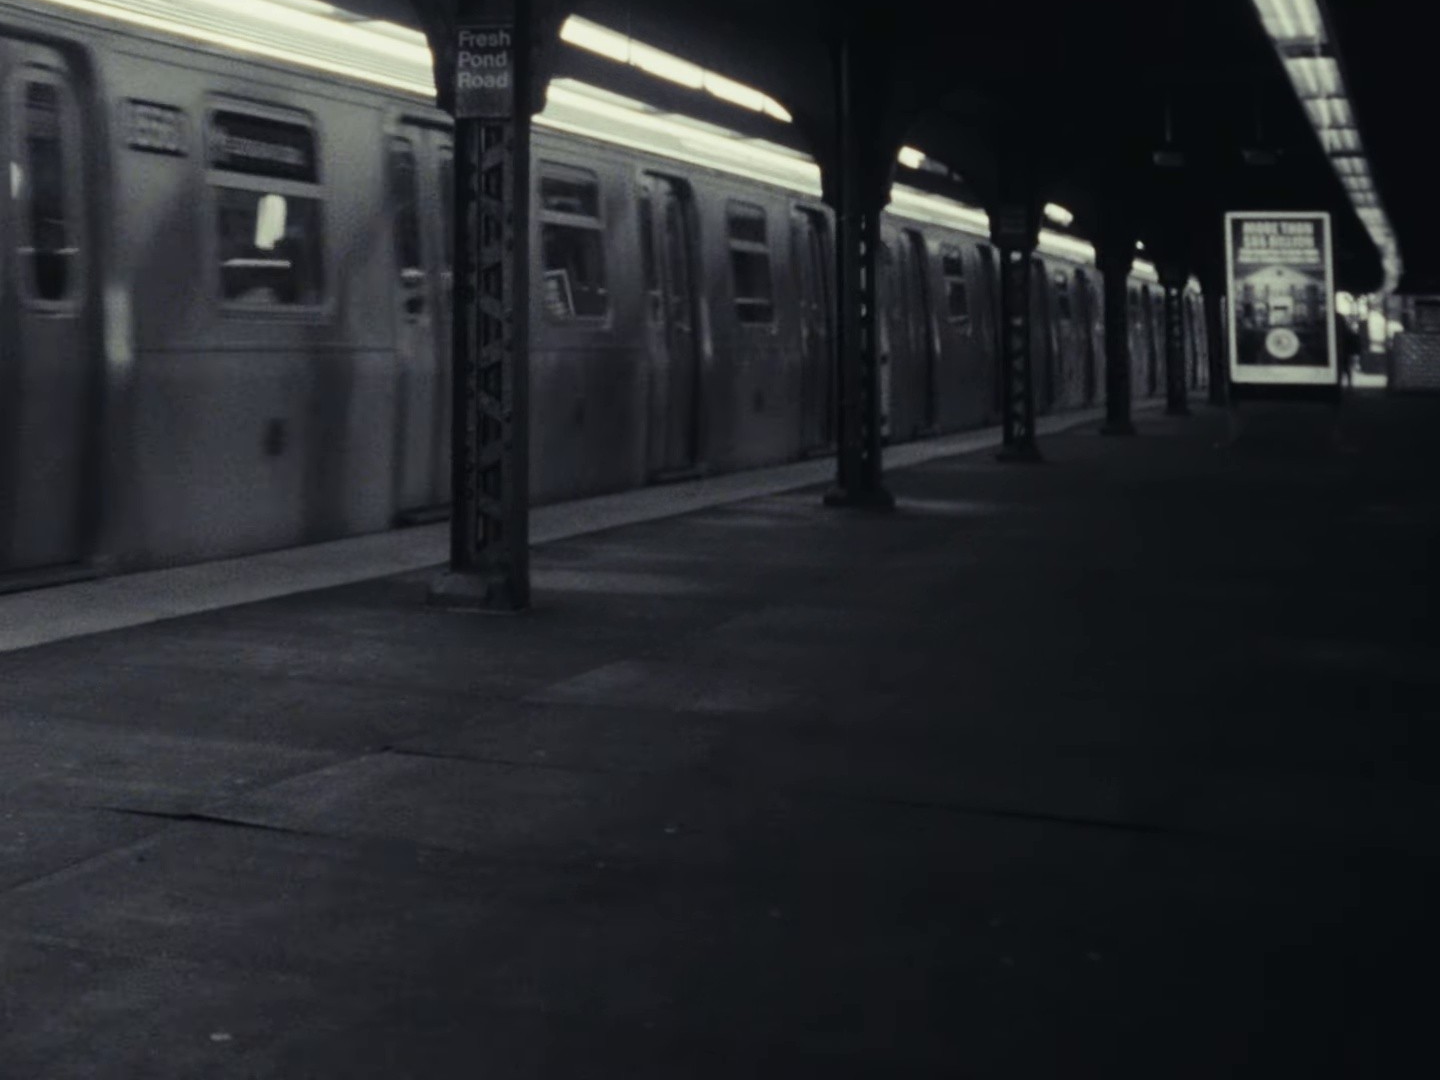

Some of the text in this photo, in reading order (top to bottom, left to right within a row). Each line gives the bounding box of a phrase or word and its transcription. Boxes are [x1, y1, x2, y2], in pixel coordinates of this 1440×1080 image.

[458, 29, 512, 48] Fresh
[458, 49, 508, 68] Pond
[457, 70, 509, 89] Road
